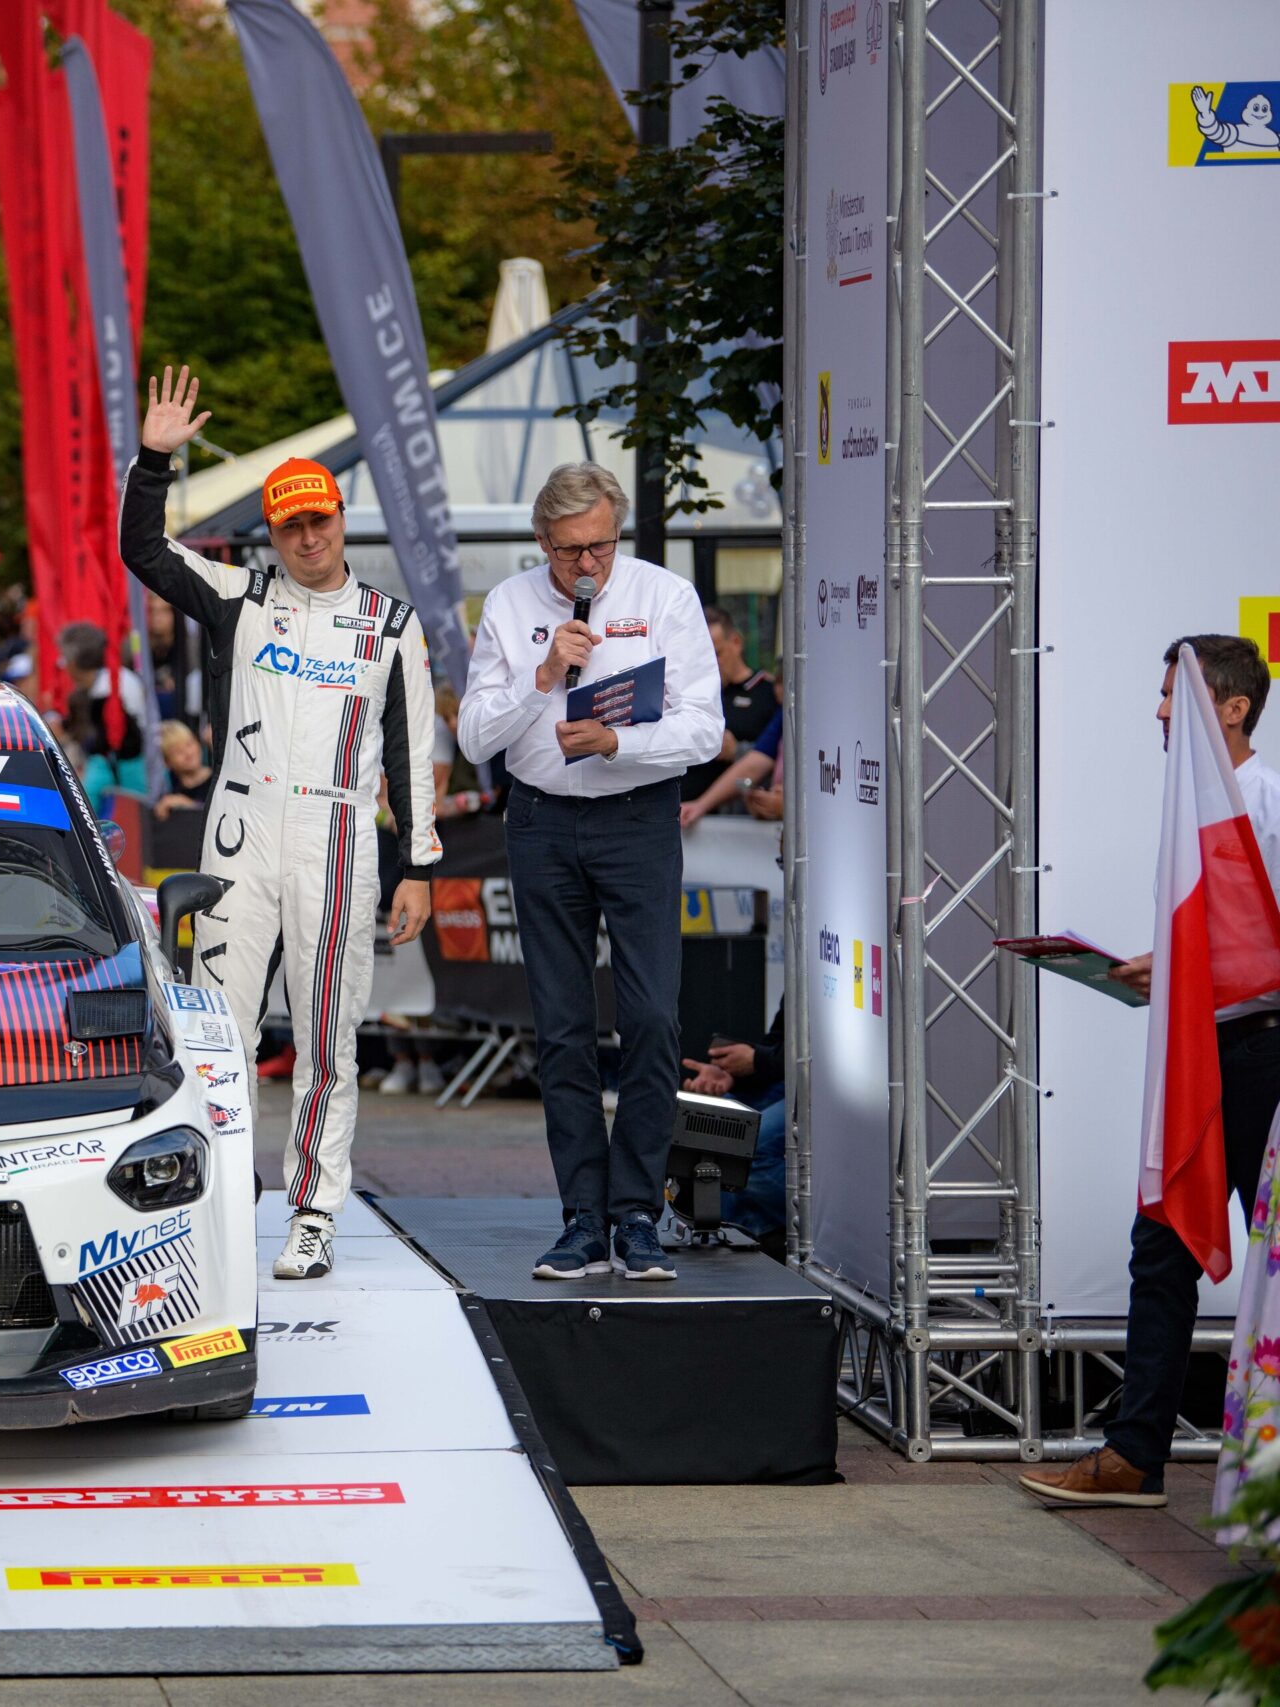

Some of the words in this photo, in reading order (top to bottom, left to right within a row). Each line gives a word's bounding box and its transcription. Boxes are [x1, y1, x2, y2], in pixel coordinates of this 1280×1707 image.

[271, 477, 324, 499] PIRELLI
[254, 642, 301, 675] ACI
[304, 657, 356, 673] TEAM
[297, 669, 357, 685] ITALIA
[859, 759, 880, 782] MOTO
[308, 788, 346, 799] A.MABELLINI
[28, 1158, 78, 1171] BRAKES
[79, 1209, 191, 1273] Mynet
[170, 1330, 238, 1362] PIRELLI
[66, 1350, 156, 1387] sparco
[167, 1487, 387, 1504] TYRES
[40, 1567, 325, 1586] PIRELLI
